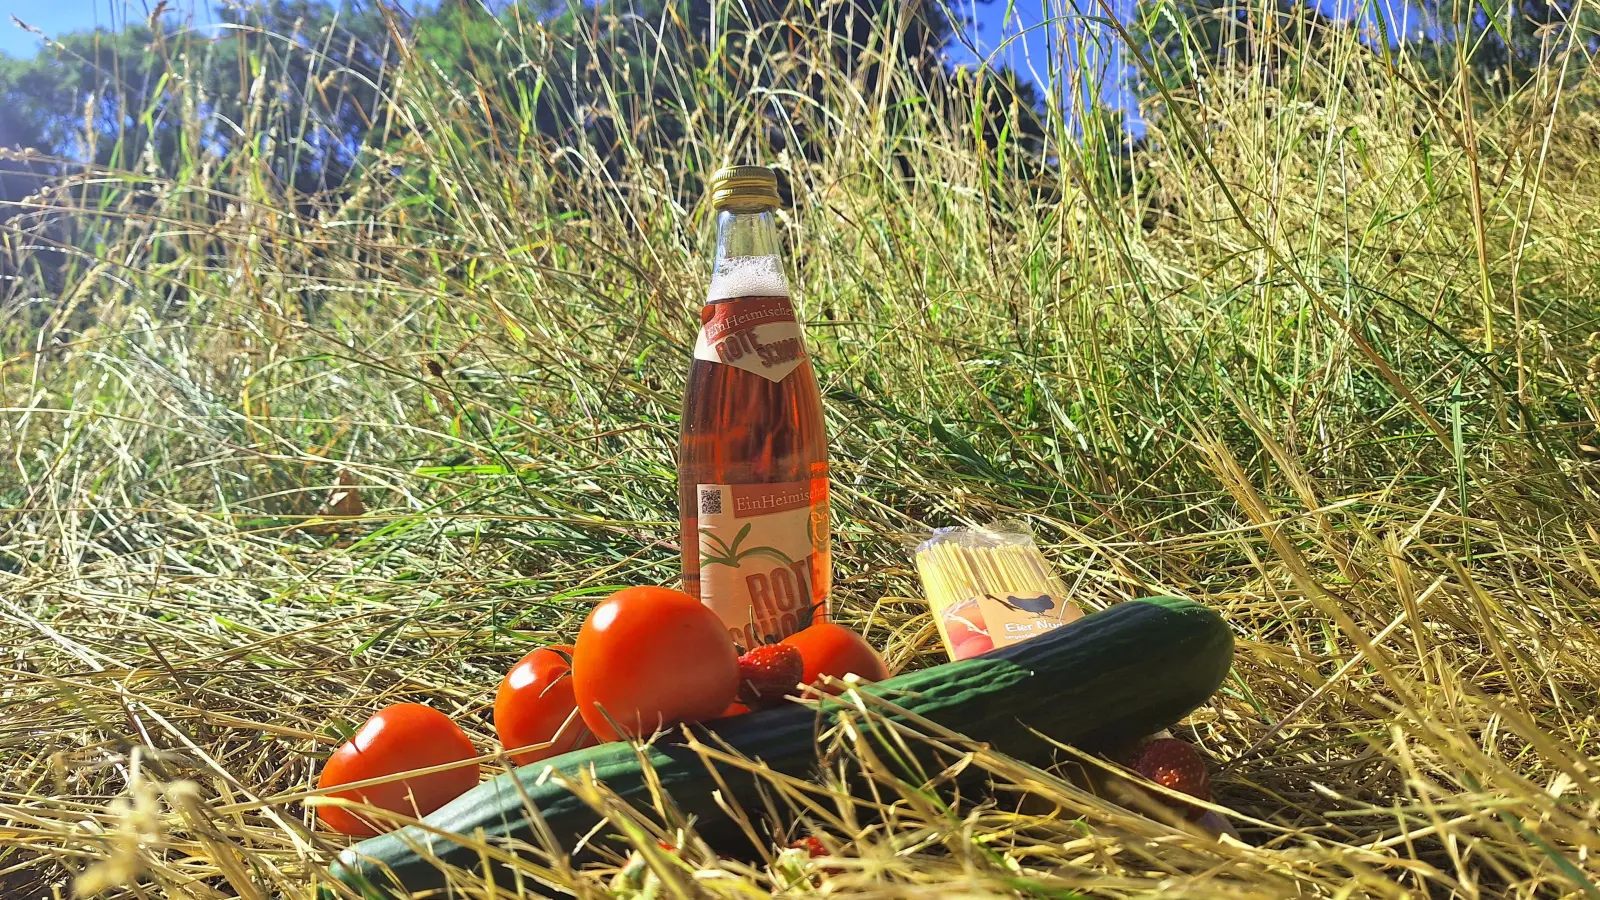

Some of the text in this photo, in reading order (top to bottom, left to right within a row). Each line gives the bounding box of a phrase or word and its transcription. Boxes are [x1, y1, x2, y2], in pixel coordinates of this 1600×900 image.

[715, 326, 758, 362] ROTE
[736, 487, 825, 511] EinHeimischer
[1005, 622, 1033, 633] Eier
